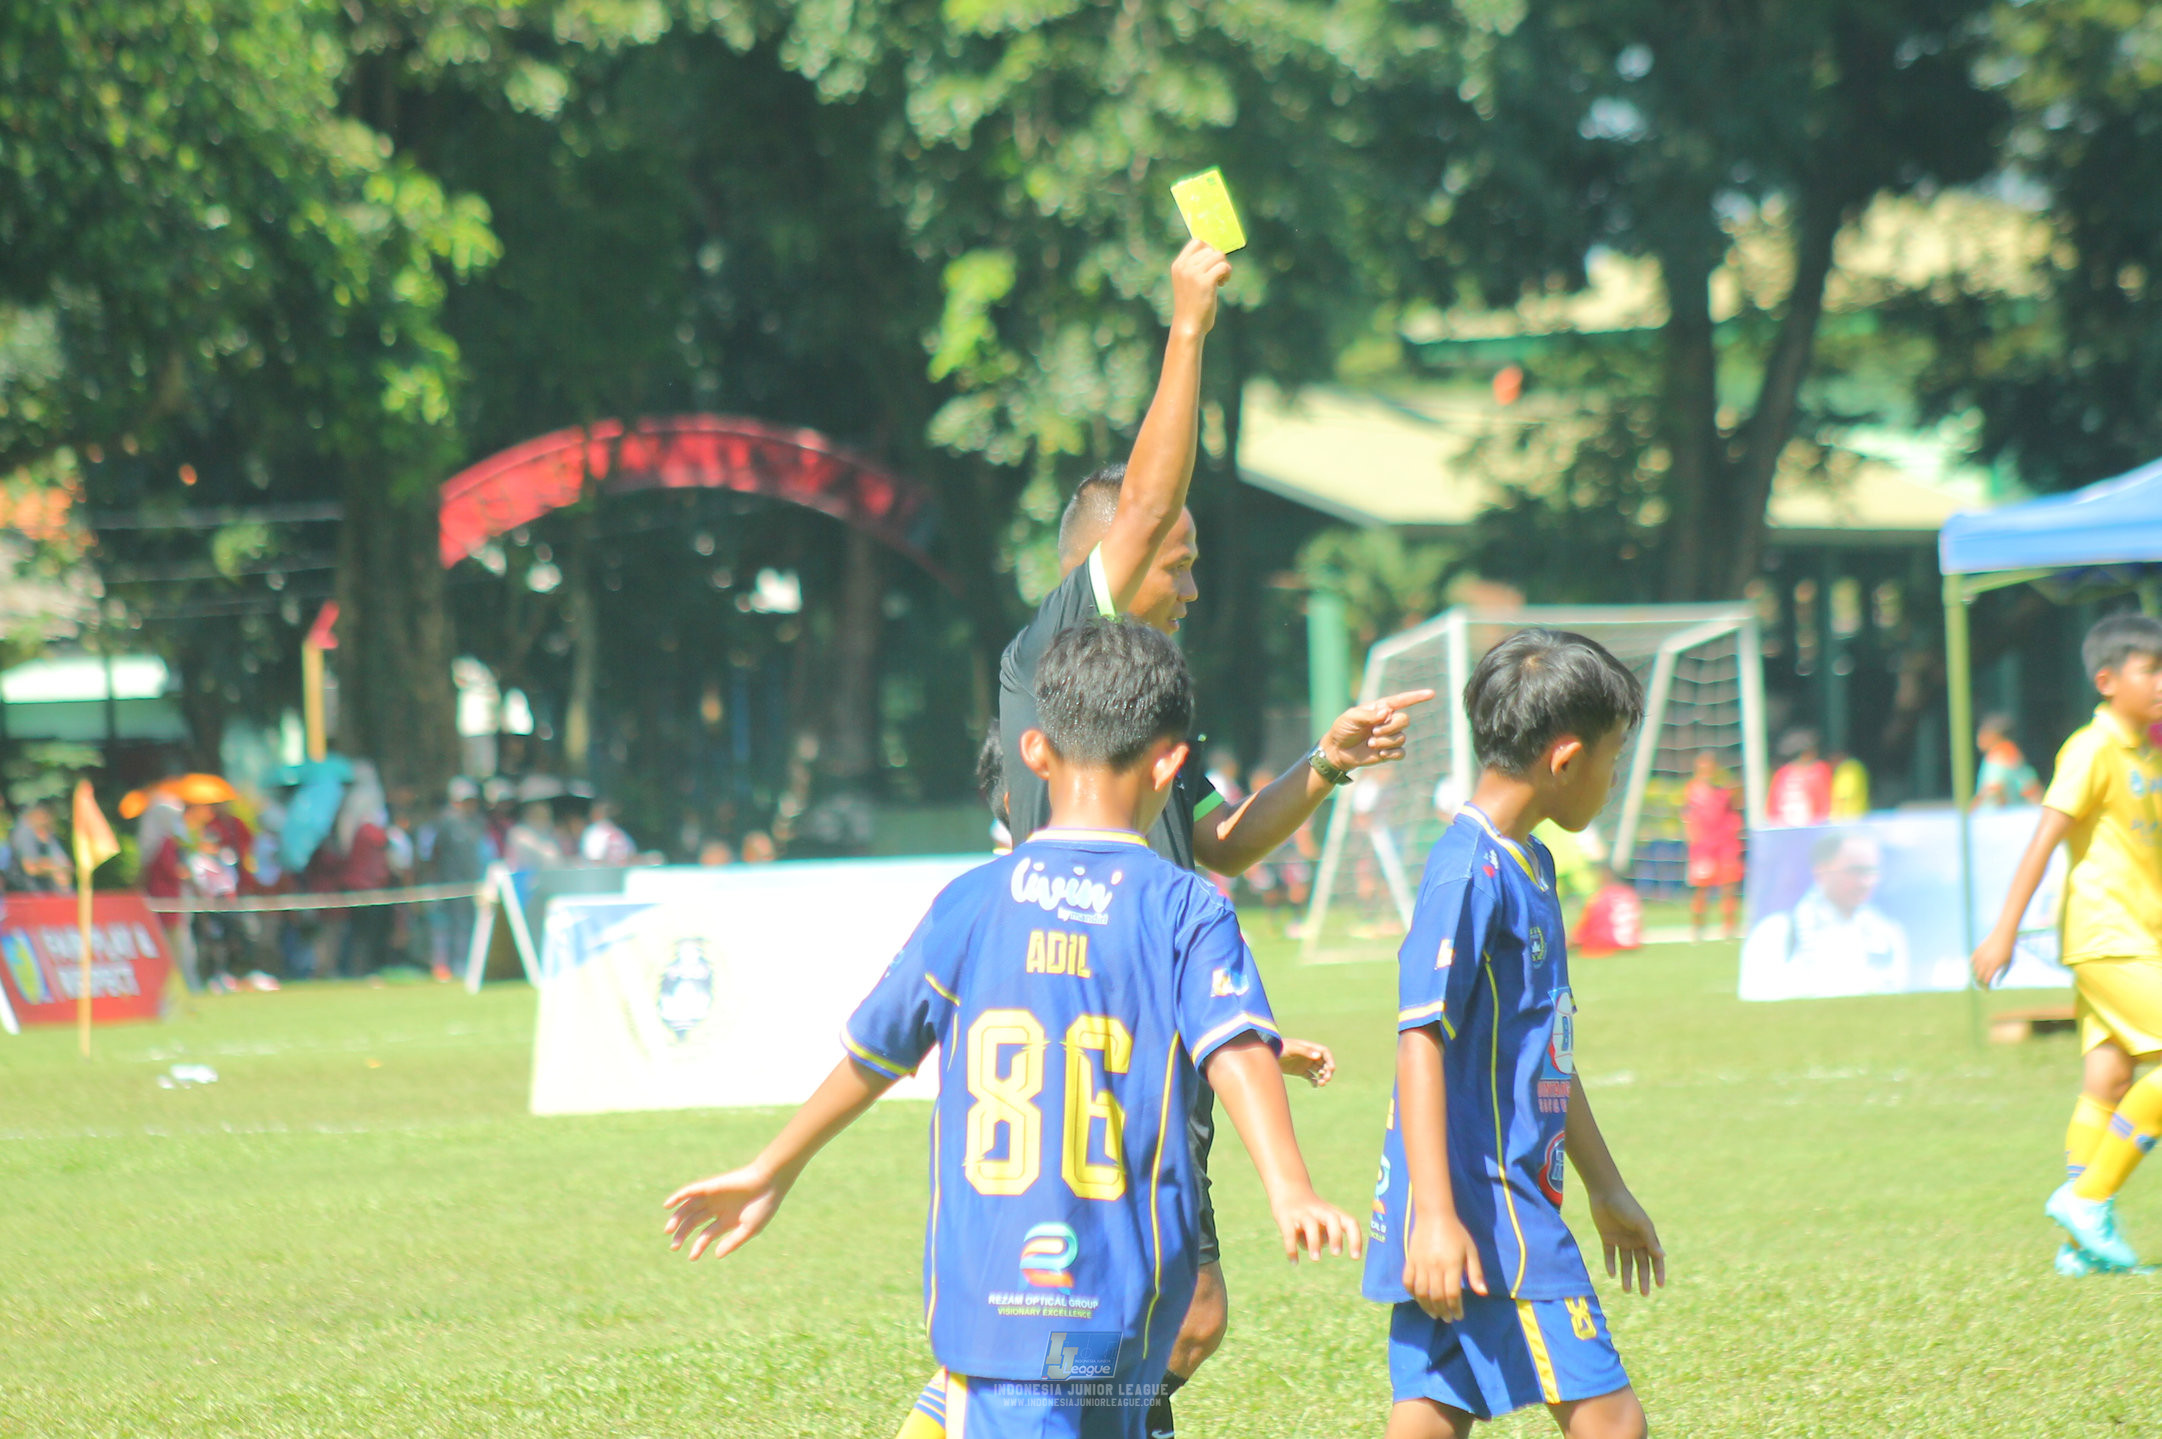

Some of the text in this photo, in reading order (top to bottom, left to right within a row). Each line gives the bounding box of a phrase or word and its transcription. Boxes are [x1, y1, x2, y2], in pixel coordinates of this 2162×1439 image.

[1070, 910, 1109, 925] mandiri
[1026, 930, 1092, 978] ADIL
[961, 1008, 1133, 1201] 86
[988, 1293, 1099, 1309] REZAM OPTICAL GROUP
[997, 1306, 1093, 1319] VISIONARY EXCELLENCE
